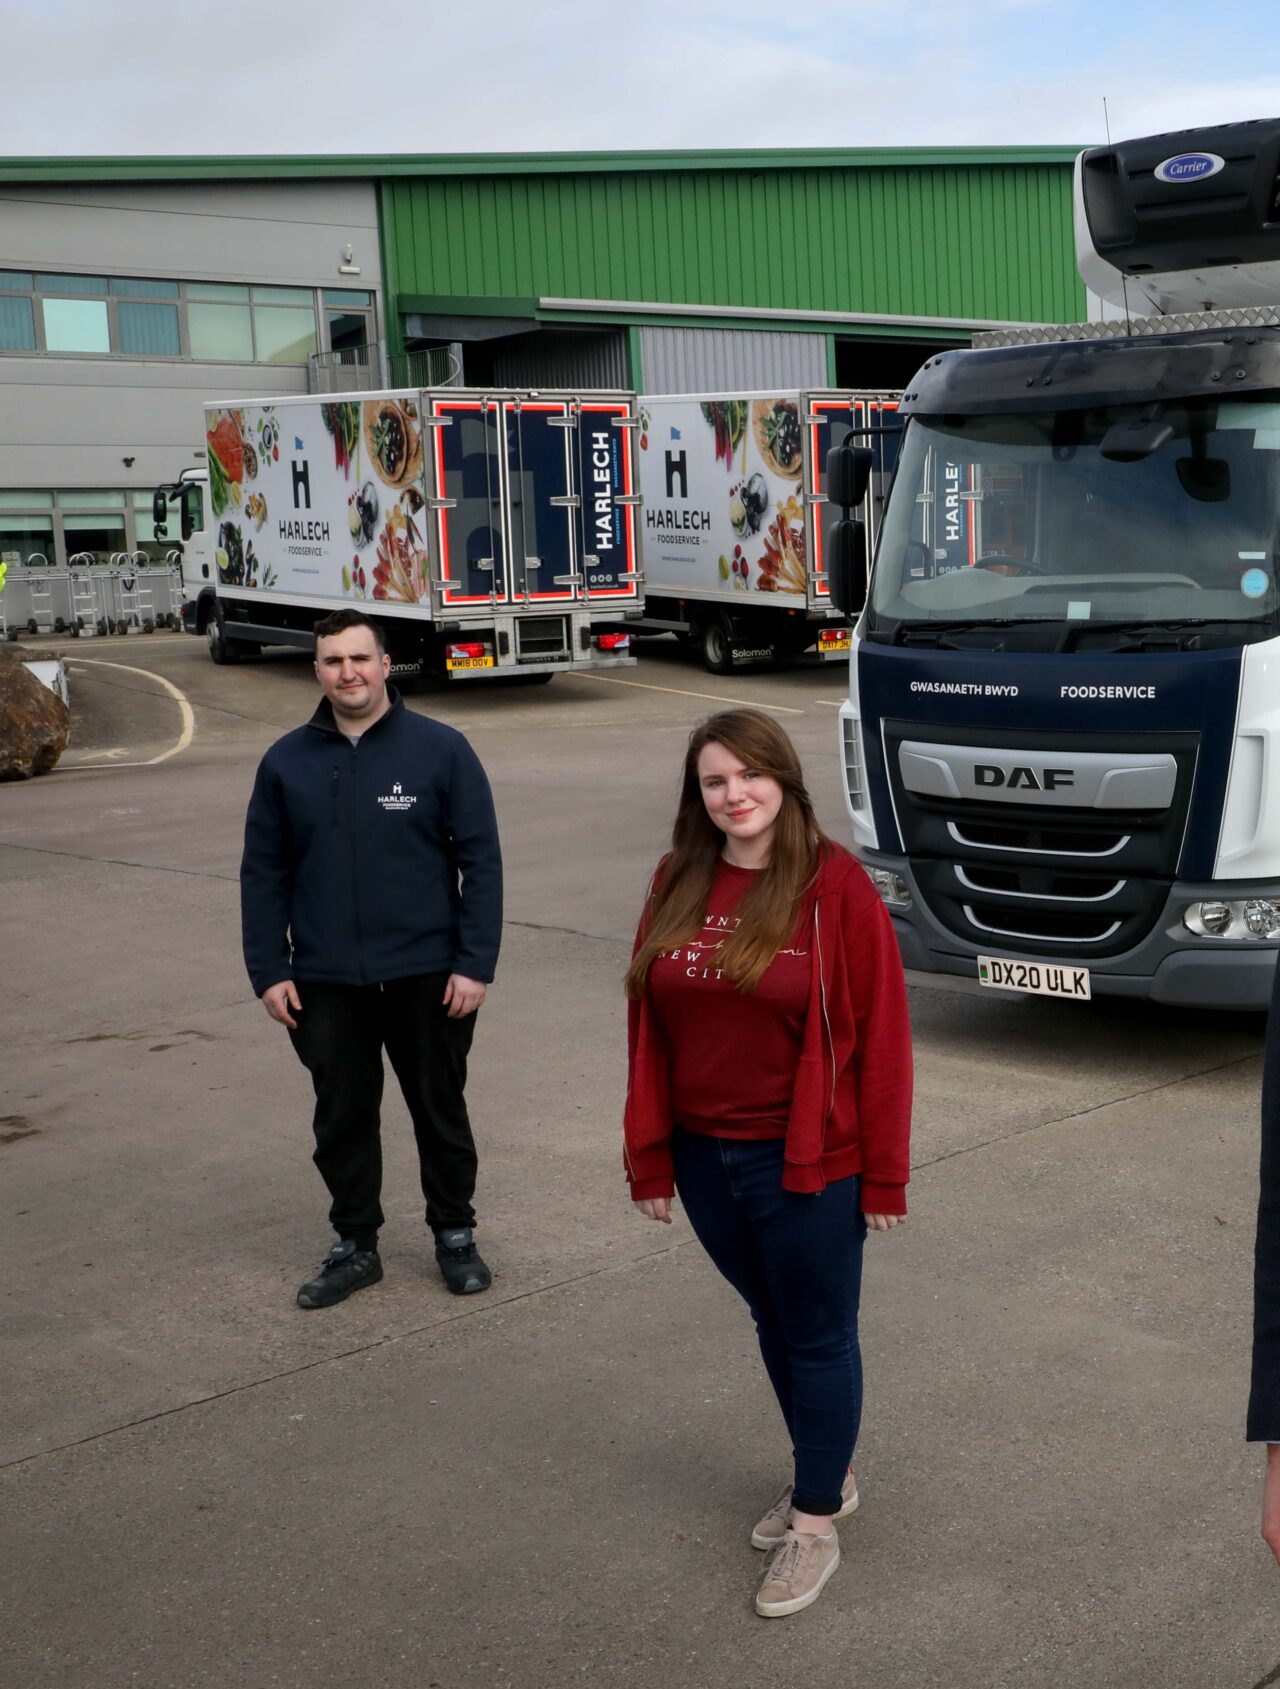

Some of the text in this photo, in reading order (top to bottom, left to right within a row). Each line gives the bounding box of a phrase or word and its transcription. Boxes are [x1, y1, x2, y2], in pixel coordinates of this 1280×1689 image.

[1170, 161, 1208, 175] Carrier
[590, 432, 614, 549] HARLECH
[646, 509, 711, 531] HARLECH
[279, 519, 330, 541] HARLECH
[657, 534, 700, 546] FOODSERVICE
[288, 545, 322, 556] FOODSERVICE
[732, 648, 772, 658] Solomon
[390, 661, 420, 672] omon
[910, 681, 1019, 697] GWASANAETH BWYD
[1060, 686, 1156, 699] FOODSERVICE
[973, 764, 1074, 791] DAF
[686, 966, 725, 980] CIT
[990, 960, 1087, 996] DX20 ULK
